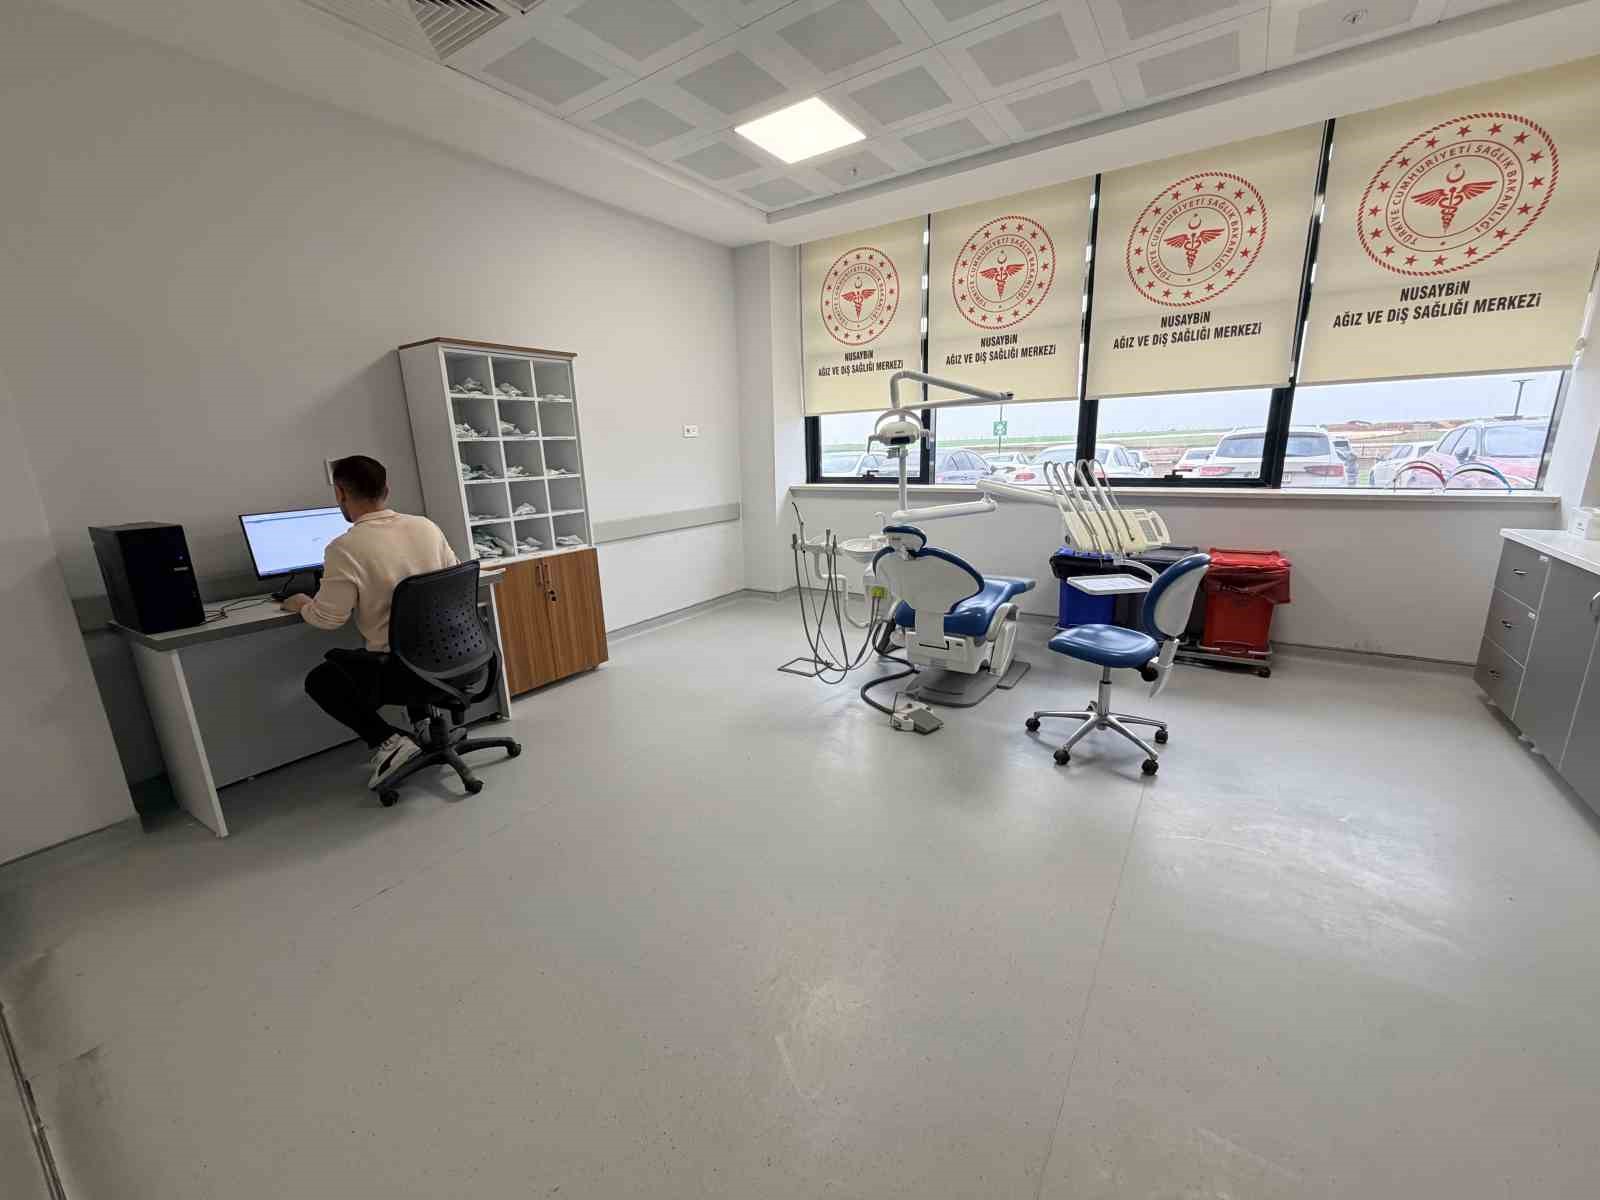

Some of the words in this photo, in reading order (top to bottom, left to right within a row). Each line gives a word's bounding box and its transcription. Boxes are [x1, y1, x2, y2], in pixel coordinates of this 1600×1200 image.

[1333, 312, 1362, 328] AĞIZ
[1367, 310, 1383, 325] VE
[1413, 299, 1468, 320] SAĞLIĞI
[1113, 335, 1134, 350] AĞIZ
[1138, 335, 1149, 347] VE
[1171, 326, 1210, 344] SAĞLIĞI
[946, 354, 962, 366] AĞIZ
[964, 353, 973, 364] VE
[989, 347, 1019, 361] SAĞLIĞI
[832, 366, 840, 376] VE
